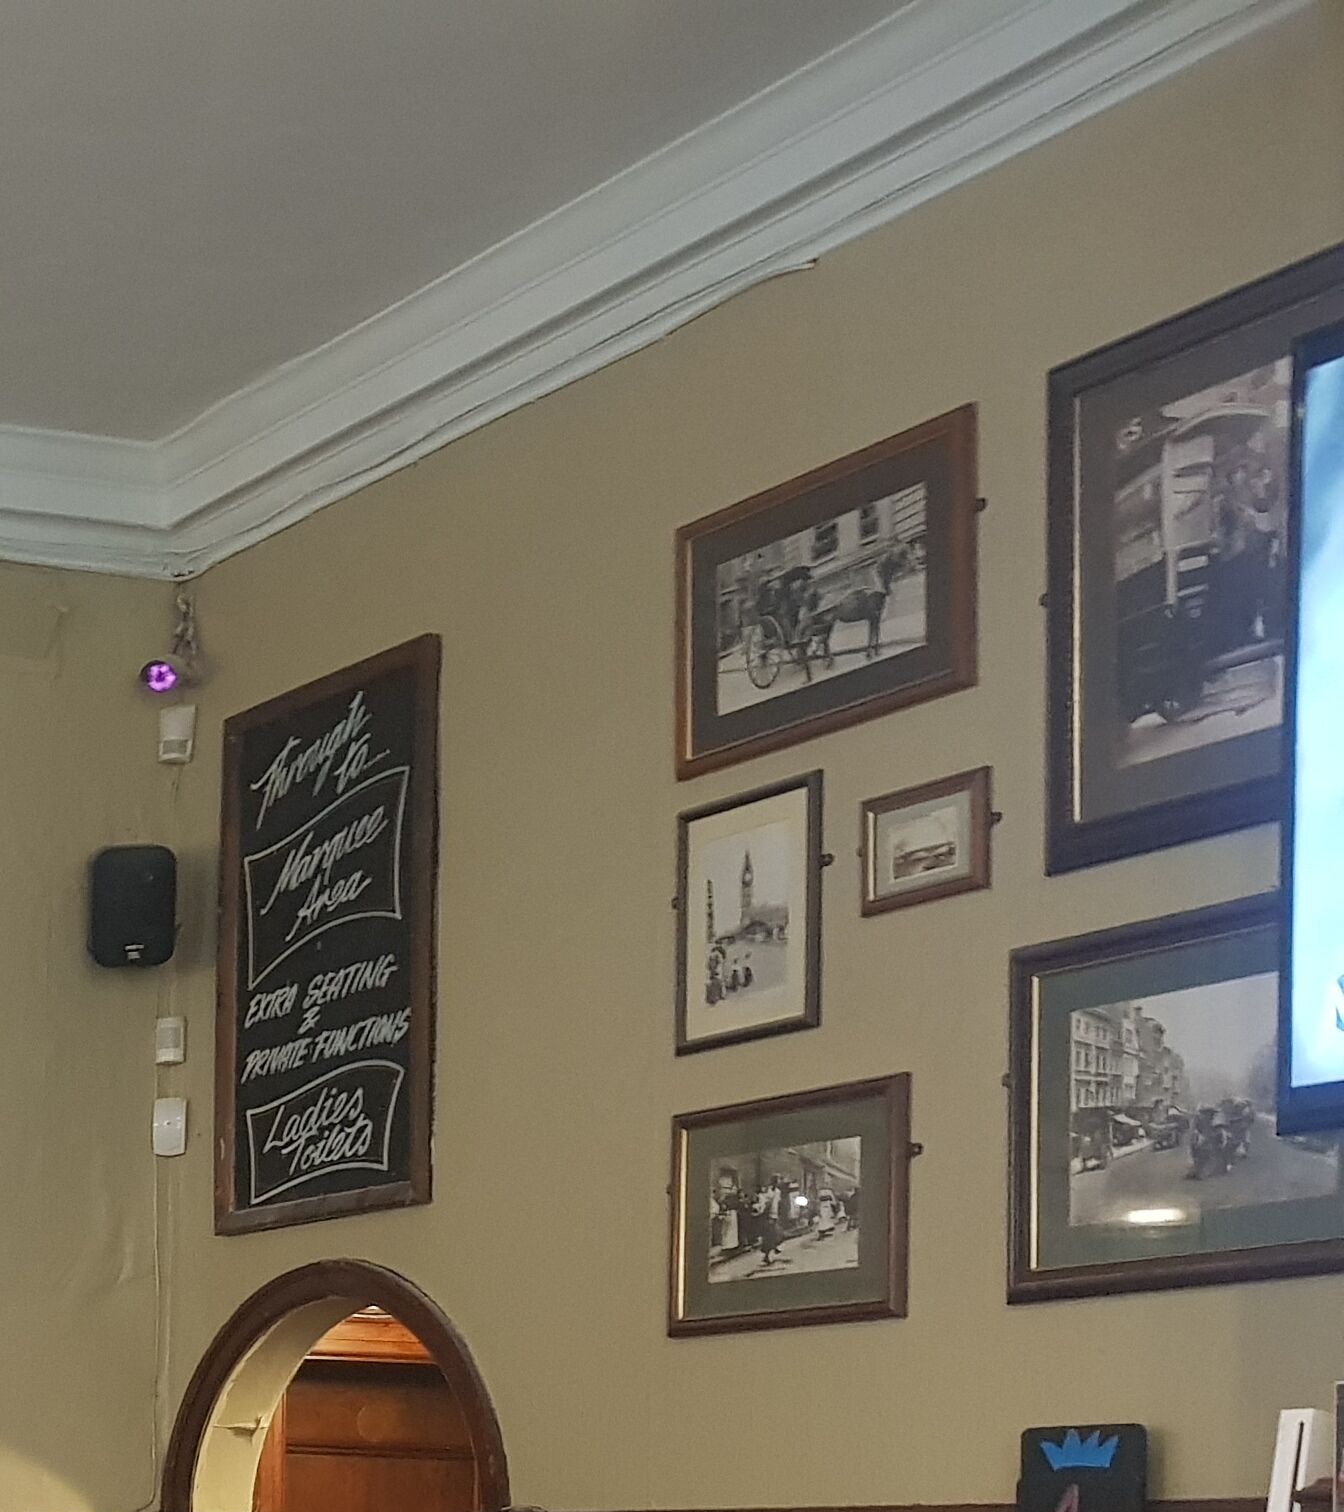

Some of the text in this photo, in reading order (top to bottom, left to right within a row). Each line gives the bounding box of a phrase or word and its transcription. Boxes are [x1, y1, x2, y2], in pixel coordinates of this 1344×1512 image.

[250, 690, 372, 831] Through
[260, 805, 389, 915] Marquee
[285, 870, 372, 941] Area
[244, 953, 399, 1029] EXTRA SEATING
[241, 1007, 412, 1085] PRIVATE FUNCTIONS
[263, 1087, 363, 1154] Ladies
[281, 1113, 373, 1175] Toilets
